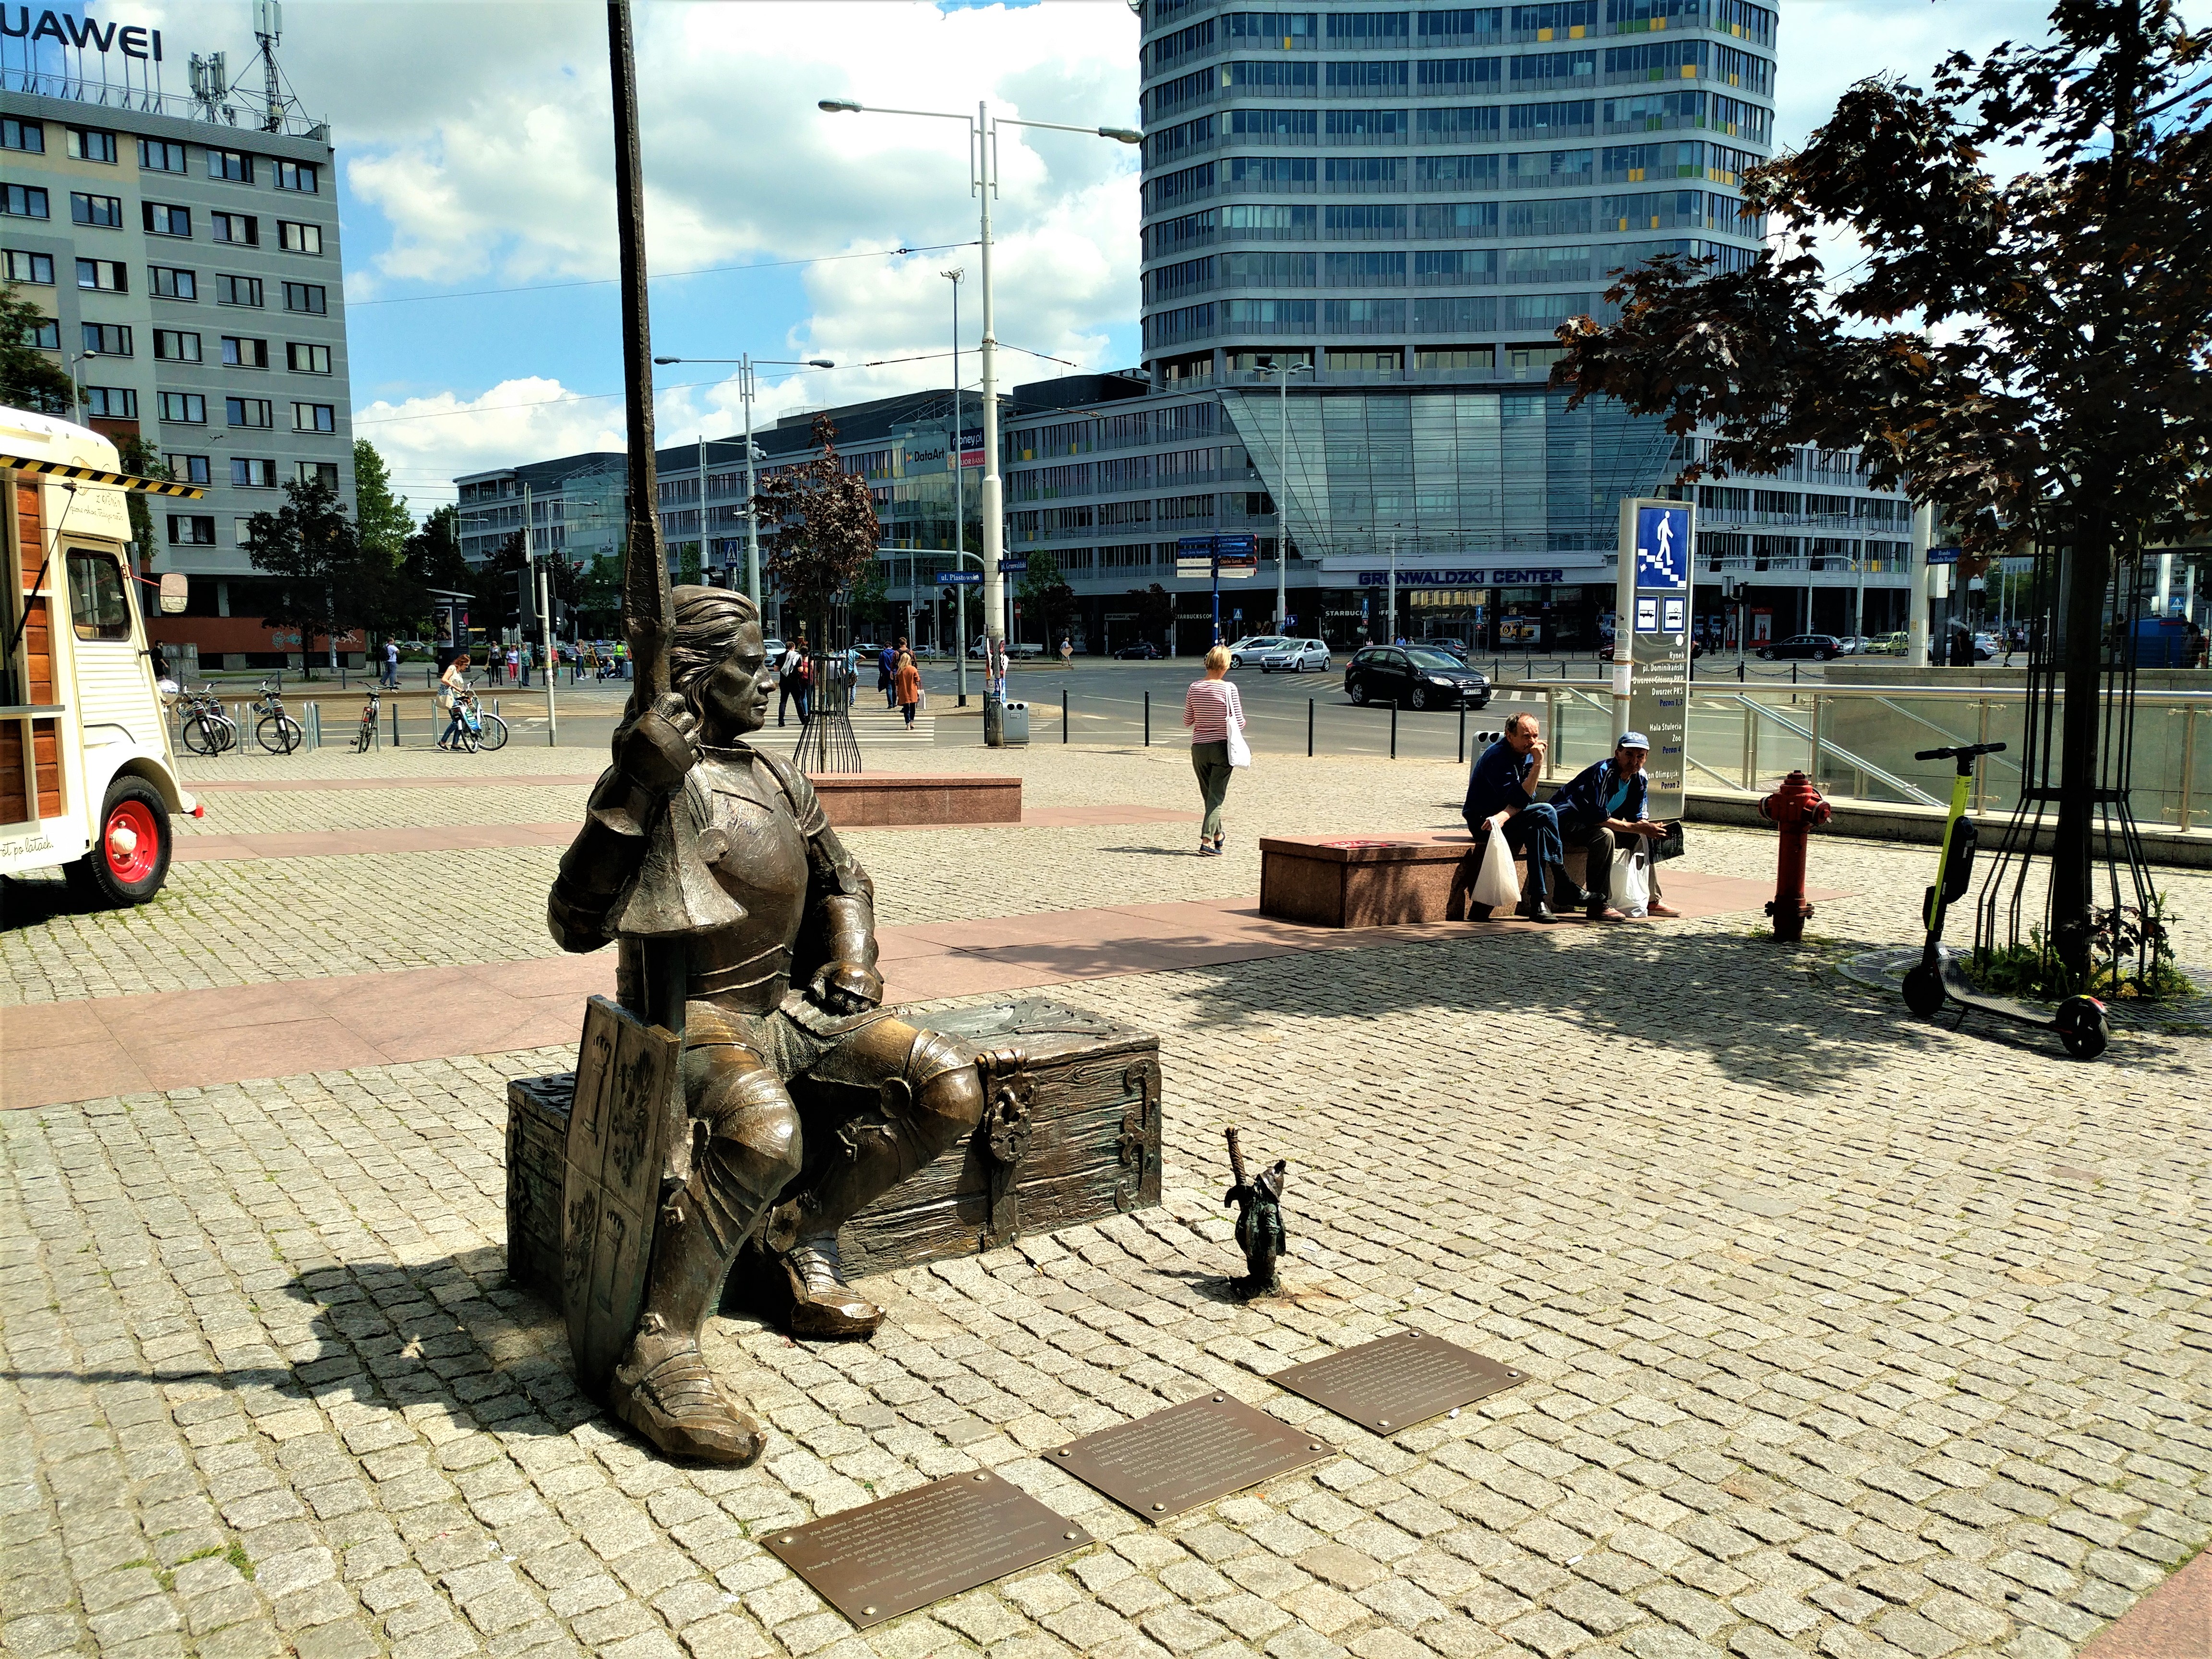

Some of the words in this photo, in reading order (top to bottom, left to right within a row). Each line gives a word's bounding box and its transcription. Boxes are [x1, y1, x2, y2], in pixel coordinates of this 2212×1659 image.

[914, 447, 945, 462] DataArt
[1493, 569, 1564, 583] CENTER
[1669, 651, 1684, 661] Rynek
[1650, 663, 1684, 672] Dominikański
[1654, 675, 1673, 685] Główny
[1652, 687, 1672, 696] Dworzec
[1673, 687, 1683, 695] PKS
[1649, 723, 1661, 732] Hala
[1662, 722, 1682, 731] Stulecia
[1672, 734, 1681, 742] Zoo
[1662, 746, 1677, 754] Peron
[1656, 769, 1680, 780] Olimpijski
[1661, 781, 1676, 790] Peron
[14, 846, 24, 862] po
